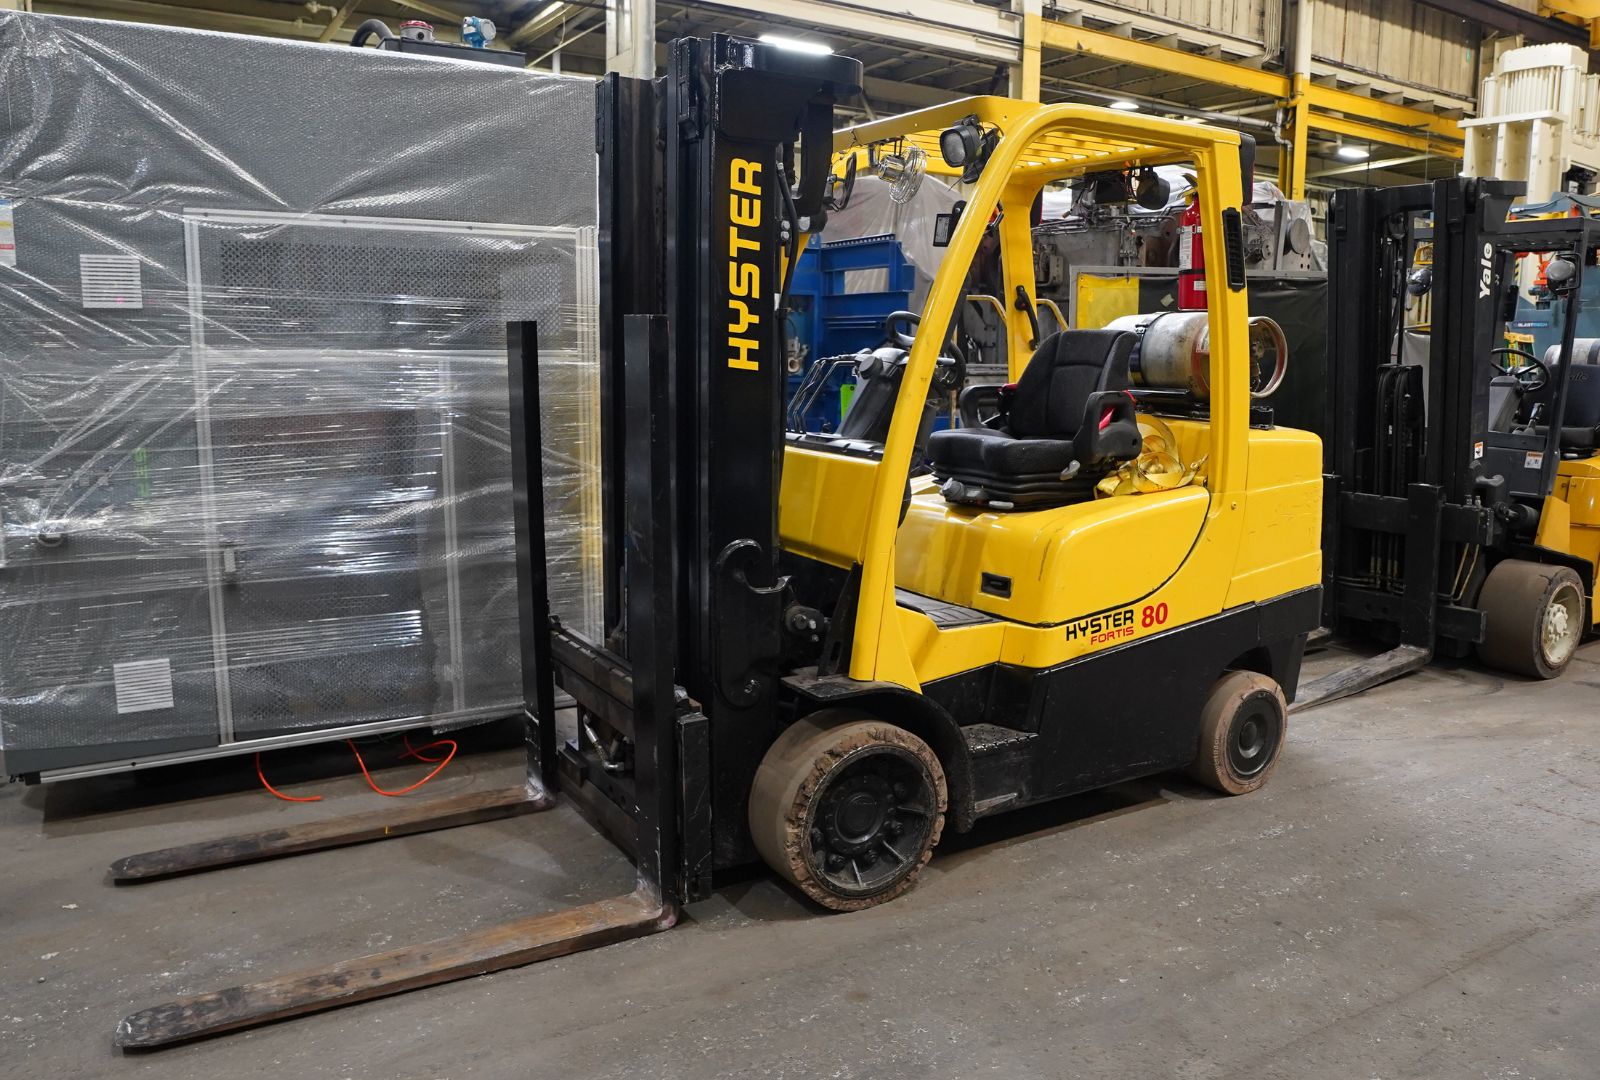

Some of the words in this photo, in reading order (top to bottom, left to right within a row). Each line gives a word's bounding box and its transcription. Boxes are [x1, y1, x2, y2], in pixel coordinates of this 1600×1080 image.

[728, 157, 762, 371] HYSTER
[1479, 242, 1493, 299] Yale
[1066, 609, 1134, 641] HYSTER
[1141, 602, 1168, 628] 80
[1090, 626, 1134, 645] FORTIS
